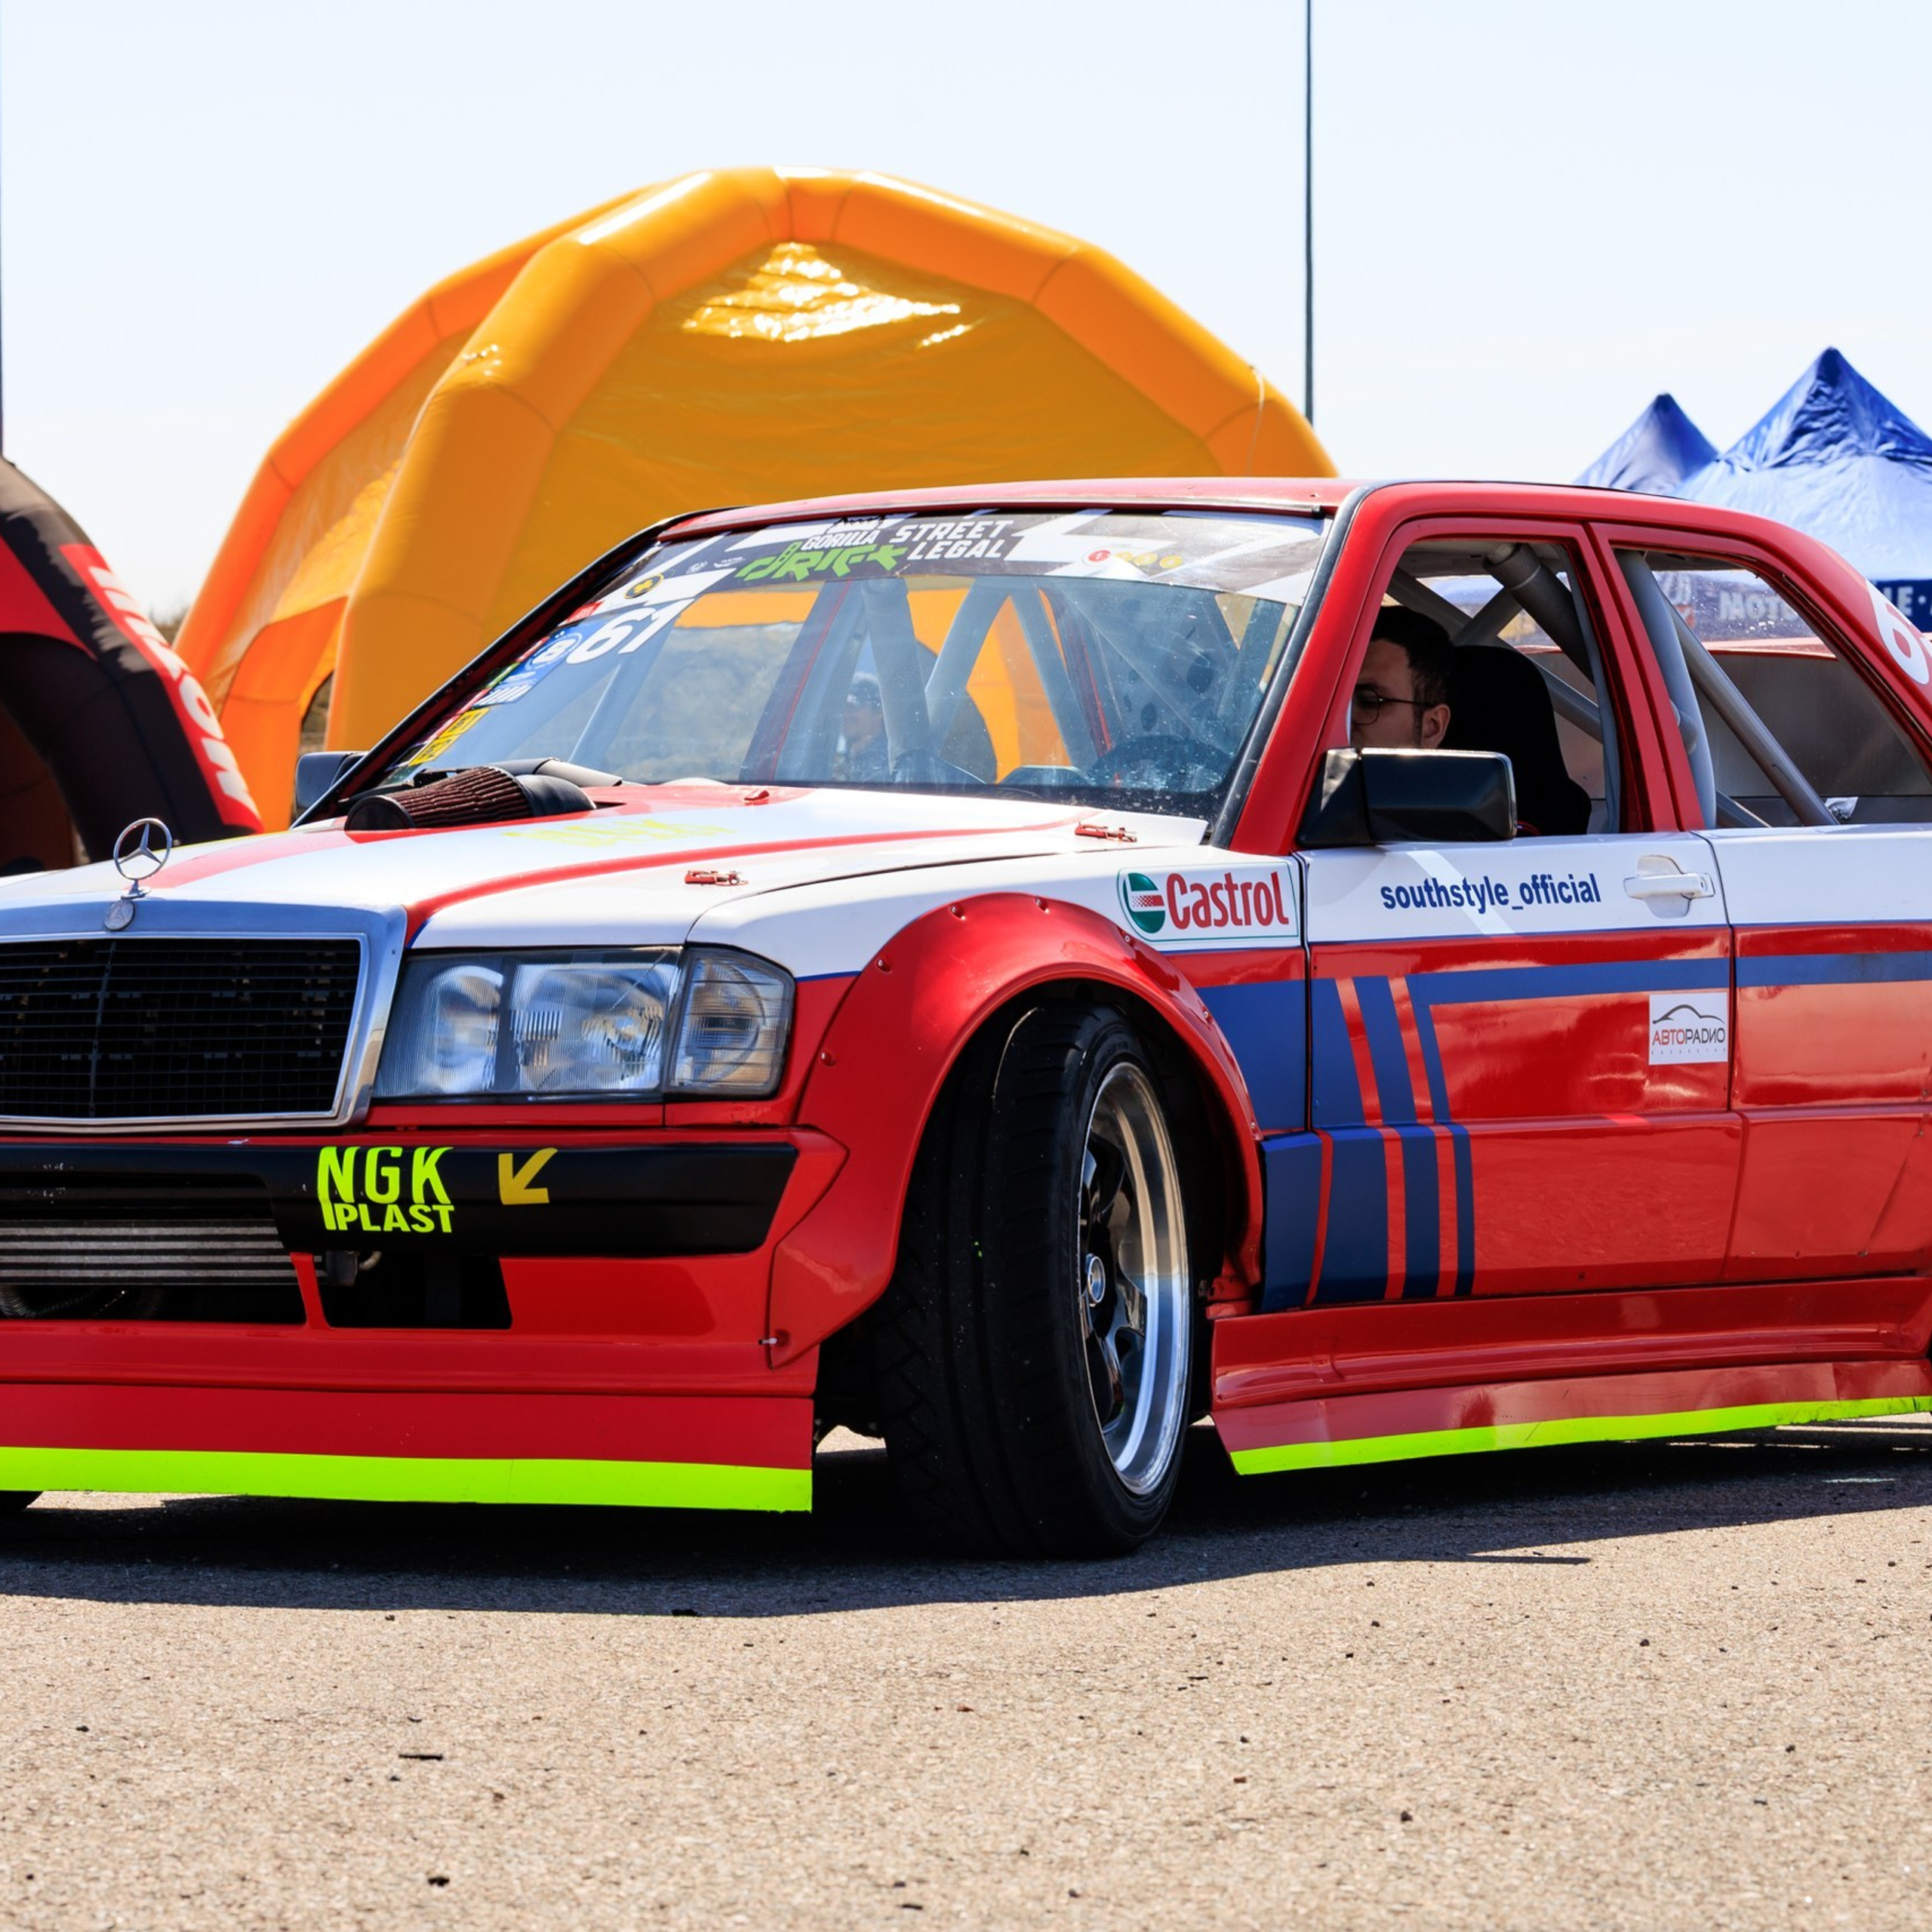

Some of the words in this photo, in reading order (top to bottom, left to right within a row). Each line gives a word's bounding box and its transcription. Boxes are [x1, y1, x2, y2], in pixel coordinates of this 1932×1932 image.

[801, 529, 876, 551] GORILLA
[889, 520, 1014, 543] STREET
[906, 539, 1005, 561] LEGAL
[566, 598, 695, 665] 61
[1165, 872, 1290, 930] Castrol
[1380, 872, 1601, 915] southstyle_official
[1652, 1027, 1726, 1046] АВТОРАДИО
[316, 1146, 455, 1209] NGK
[335, 1204, 455, 1233] PLAST
